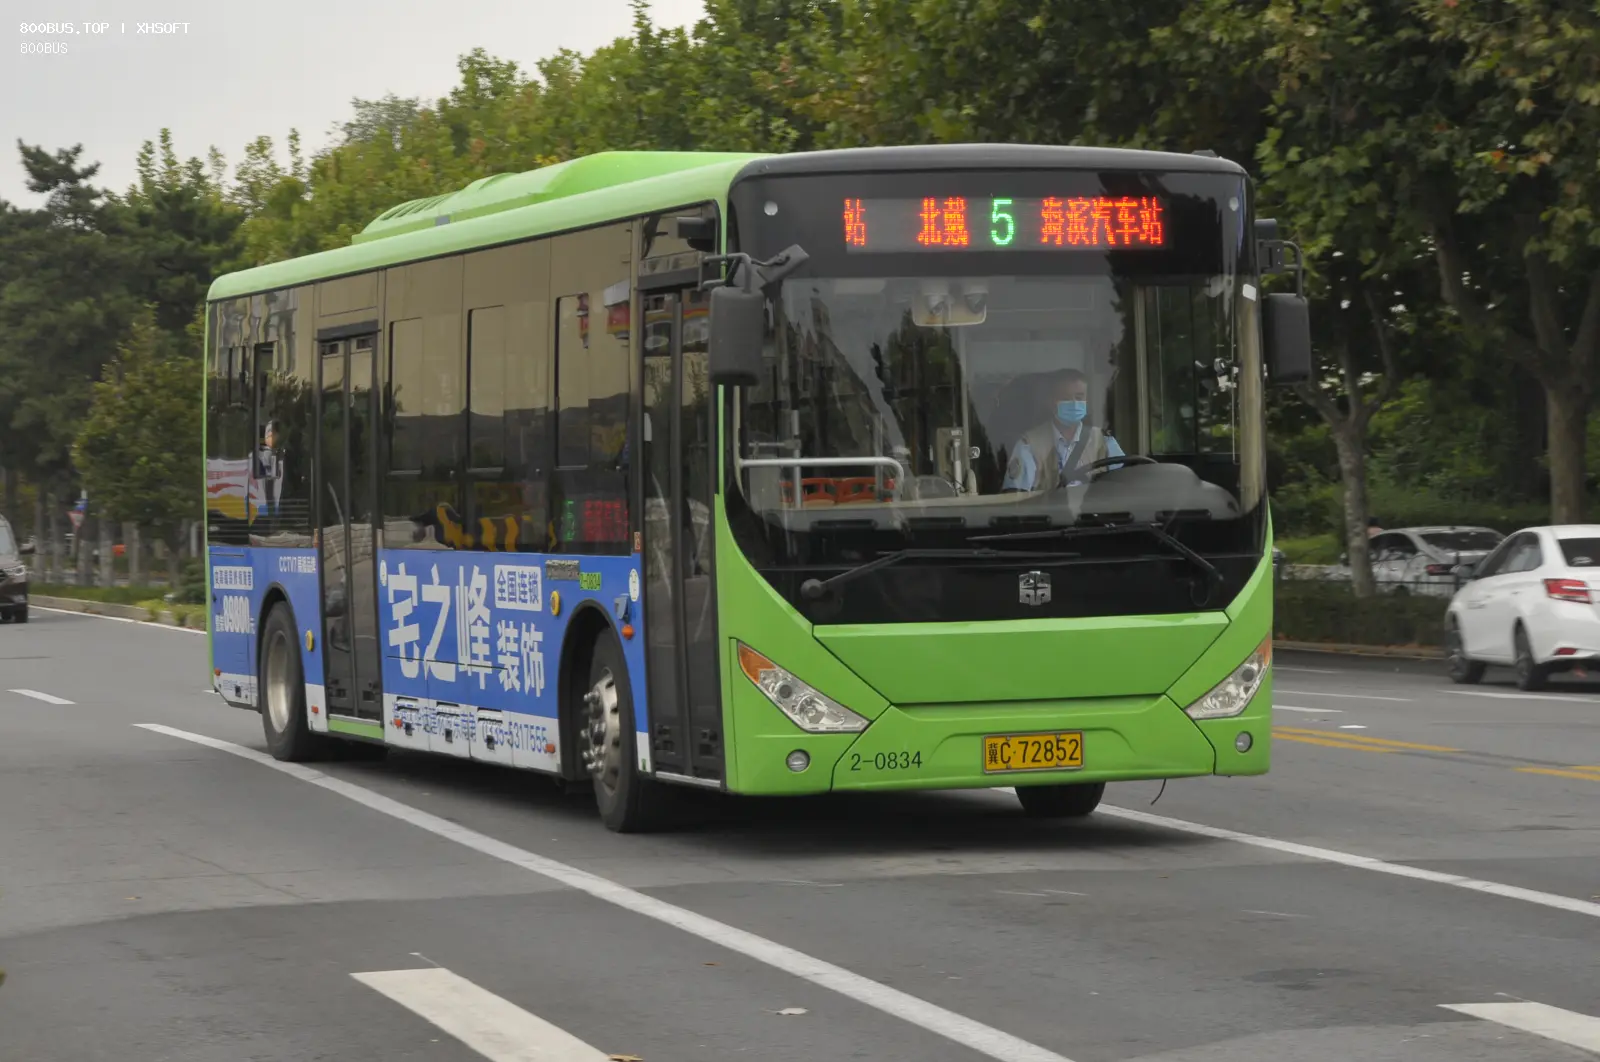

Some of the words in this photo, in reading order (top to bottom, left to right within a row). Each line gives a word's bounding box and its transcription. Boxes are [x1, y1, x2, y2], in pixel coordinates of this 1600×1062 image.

[991, 198, 1014, 246] 5
[1041, 196, 1164, 246] 海滨汽车站
[496, 569, 540, 605] 全国连锁
[387, 561, 493, 690] 宅之峰
[496, 619, 546, 698] 装饰
[850, 750, 923, 771] 2-0834
